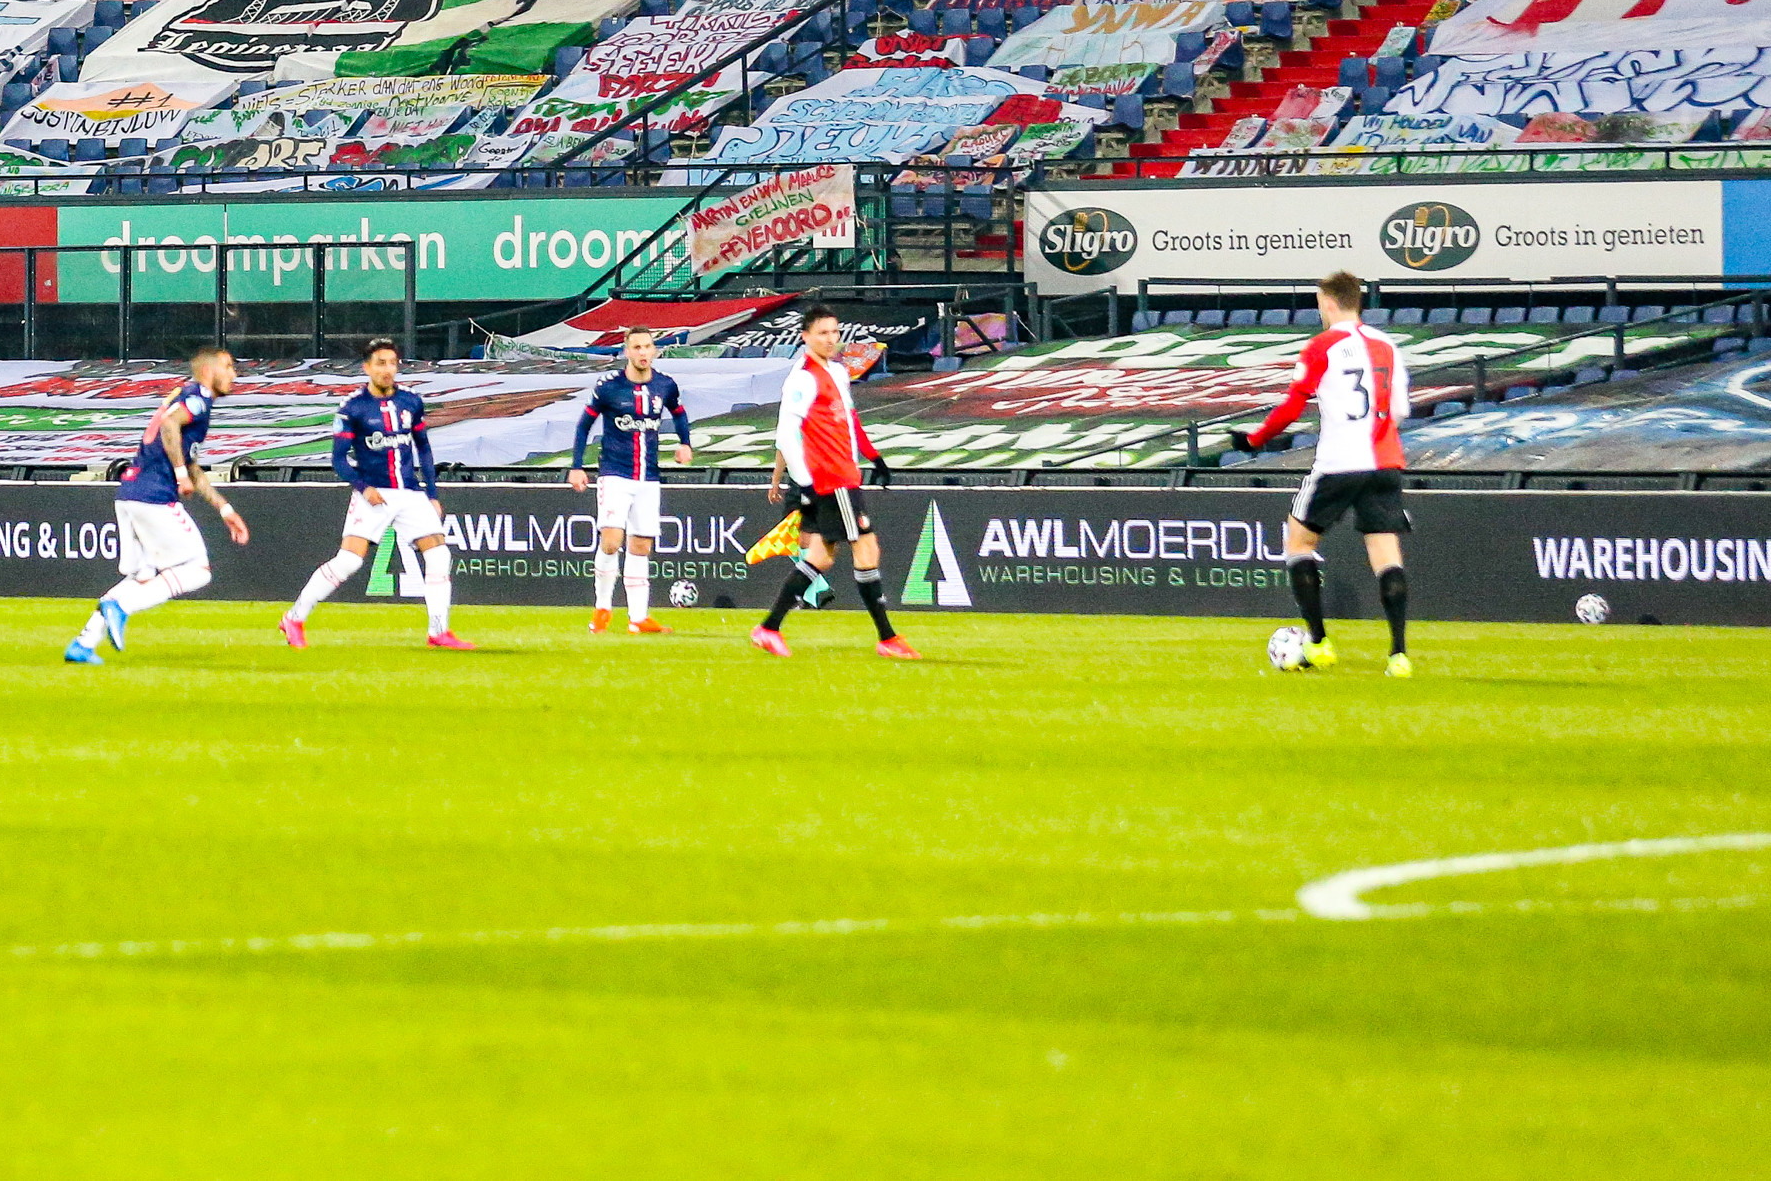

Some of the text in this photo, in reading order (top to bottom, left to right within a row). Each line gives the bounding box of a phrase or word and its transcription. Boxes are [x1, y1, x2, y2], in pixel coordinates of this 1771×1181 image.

[100, 217, 446, 285] droomparken
[1044, 221, 1353, 260] Sligro Groots in genieten
[1384, 218, 1705, 255] Sligro Groots in genieten
[37, 522, 58, 558] &
[442, 514, 746, 554] AWLMODIJK
[978, 518, 1324, 561] AWLMOERDIJ
[978, 564, 1186, 587] WAREHOUSING &
[1532, 537, 1771, 582] WAREHOUSIN
